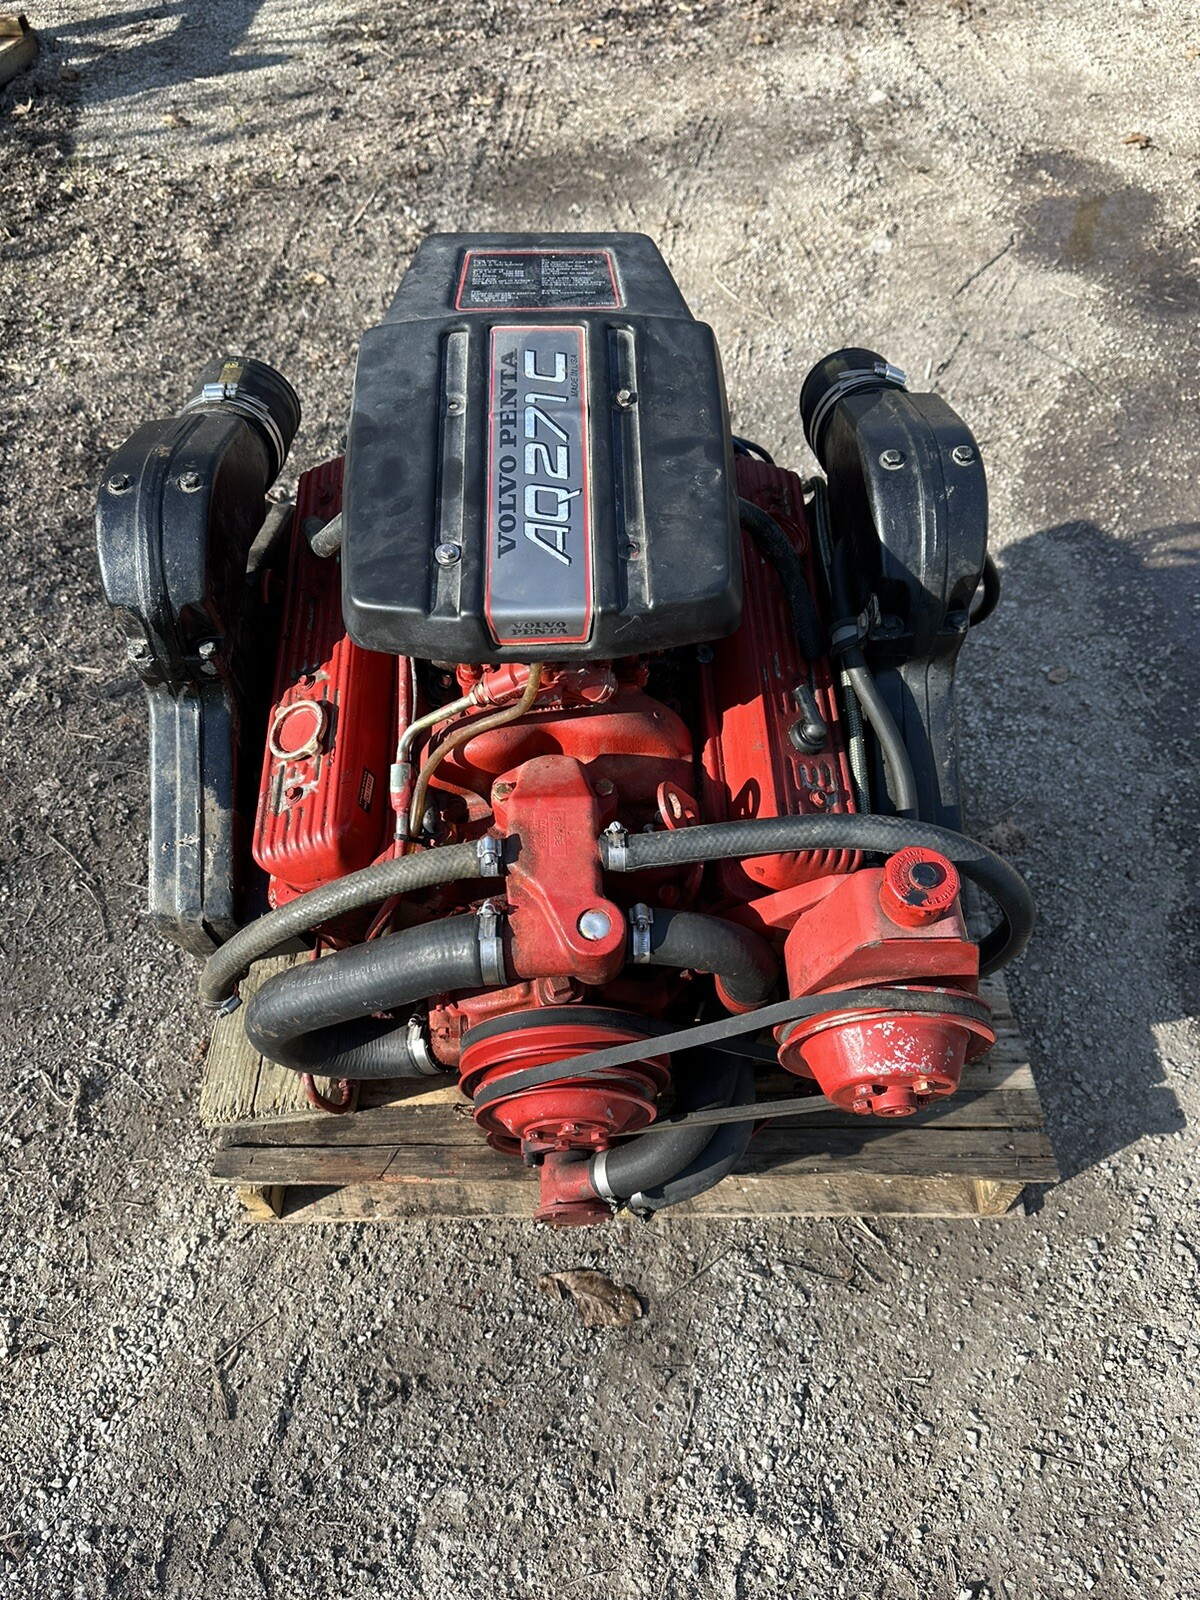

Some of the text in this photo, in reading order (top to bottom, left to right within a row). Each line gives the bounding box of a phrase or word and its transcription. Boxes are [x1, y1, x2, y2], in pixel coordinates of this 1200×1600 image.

[570, 354, 579, 397] MADE IN USA
[497, 348, 517, 559] VOLVO PENTA
